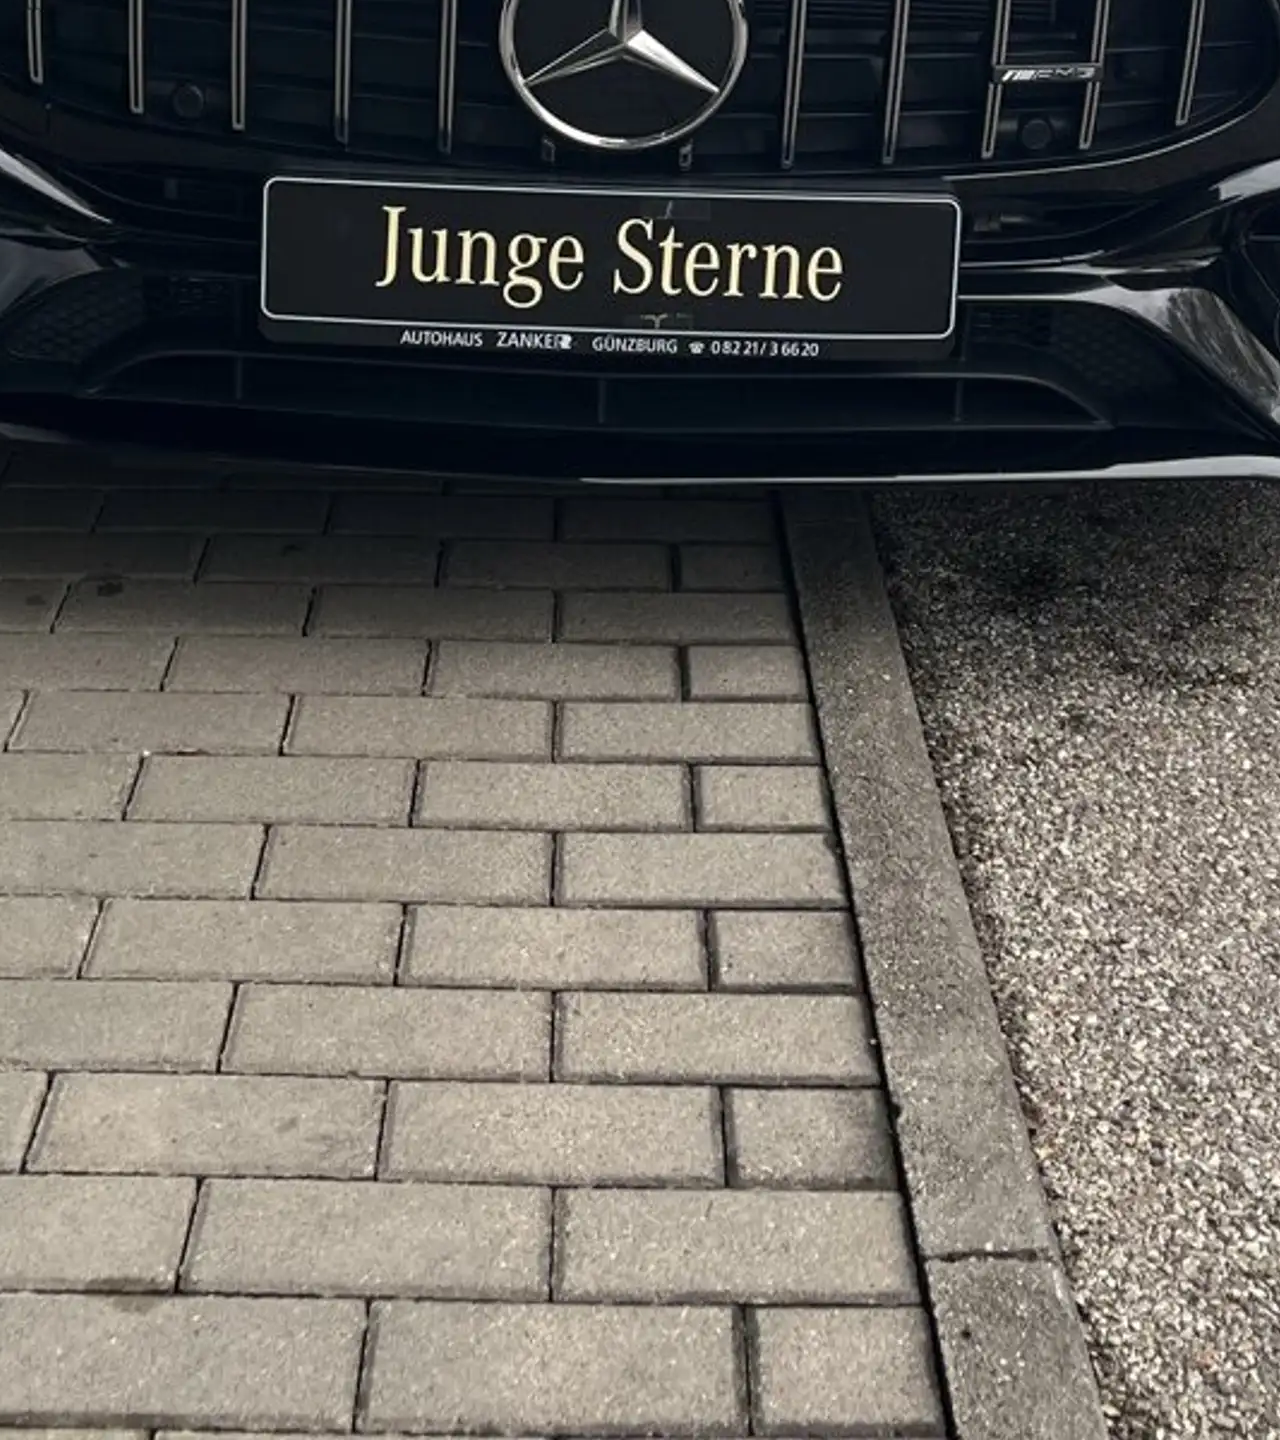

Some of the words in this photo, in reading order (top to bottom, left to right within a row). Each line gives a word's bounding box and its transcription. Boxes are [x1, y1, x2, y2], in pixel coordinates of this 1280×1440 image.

[375, 205, 585, 308] Junge
[613, 218, 843, 301] Sterne
[400, 330, 484, 348] AUTOHAUS
[591, 335, 678, 353] GÜNZBURG
